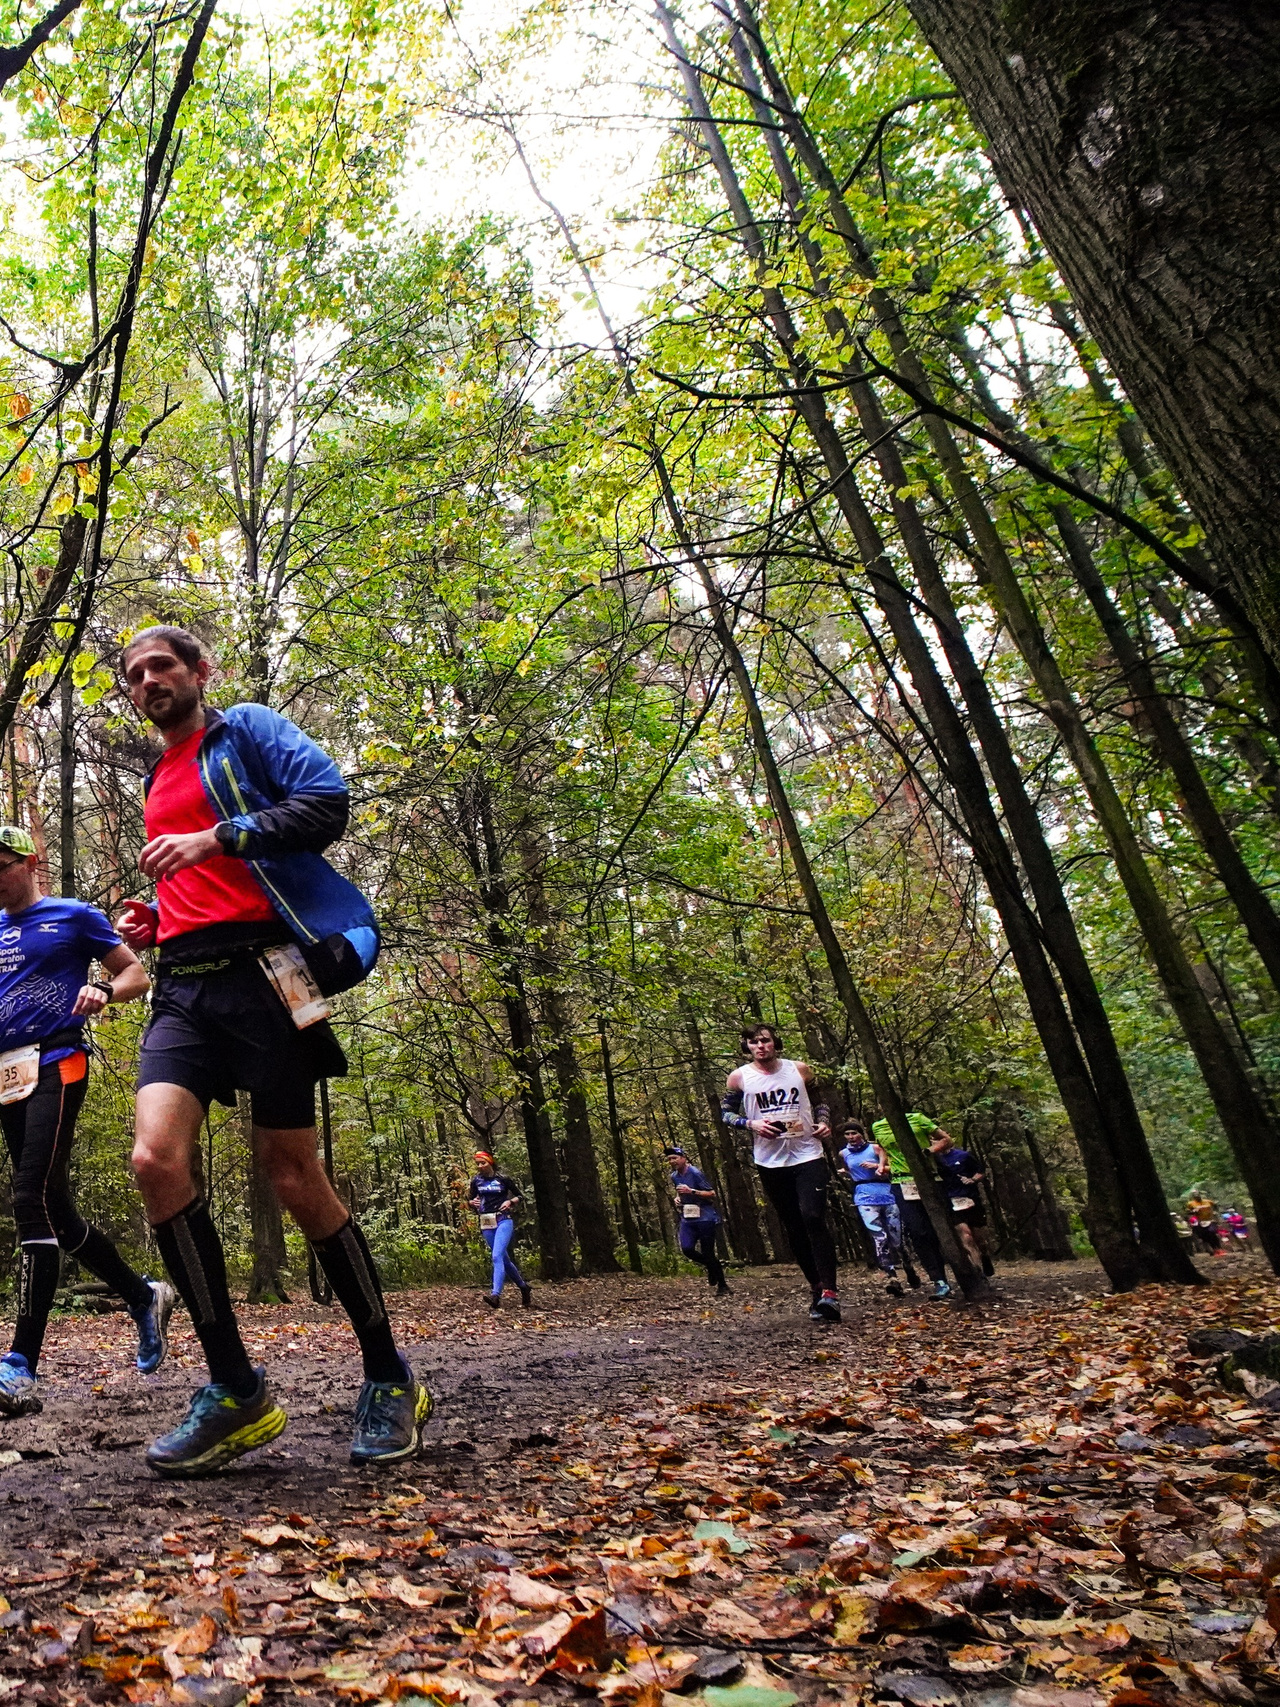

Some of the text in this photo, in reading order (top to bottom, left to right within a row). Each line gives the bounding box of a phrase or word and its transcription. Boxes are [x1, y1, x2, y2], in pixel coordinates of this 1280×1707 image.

[171, 959, 230, 975] POWERUP
[4, 1066, 18, 1082] 35
[755, 1087, 799, 1109] M42.2
